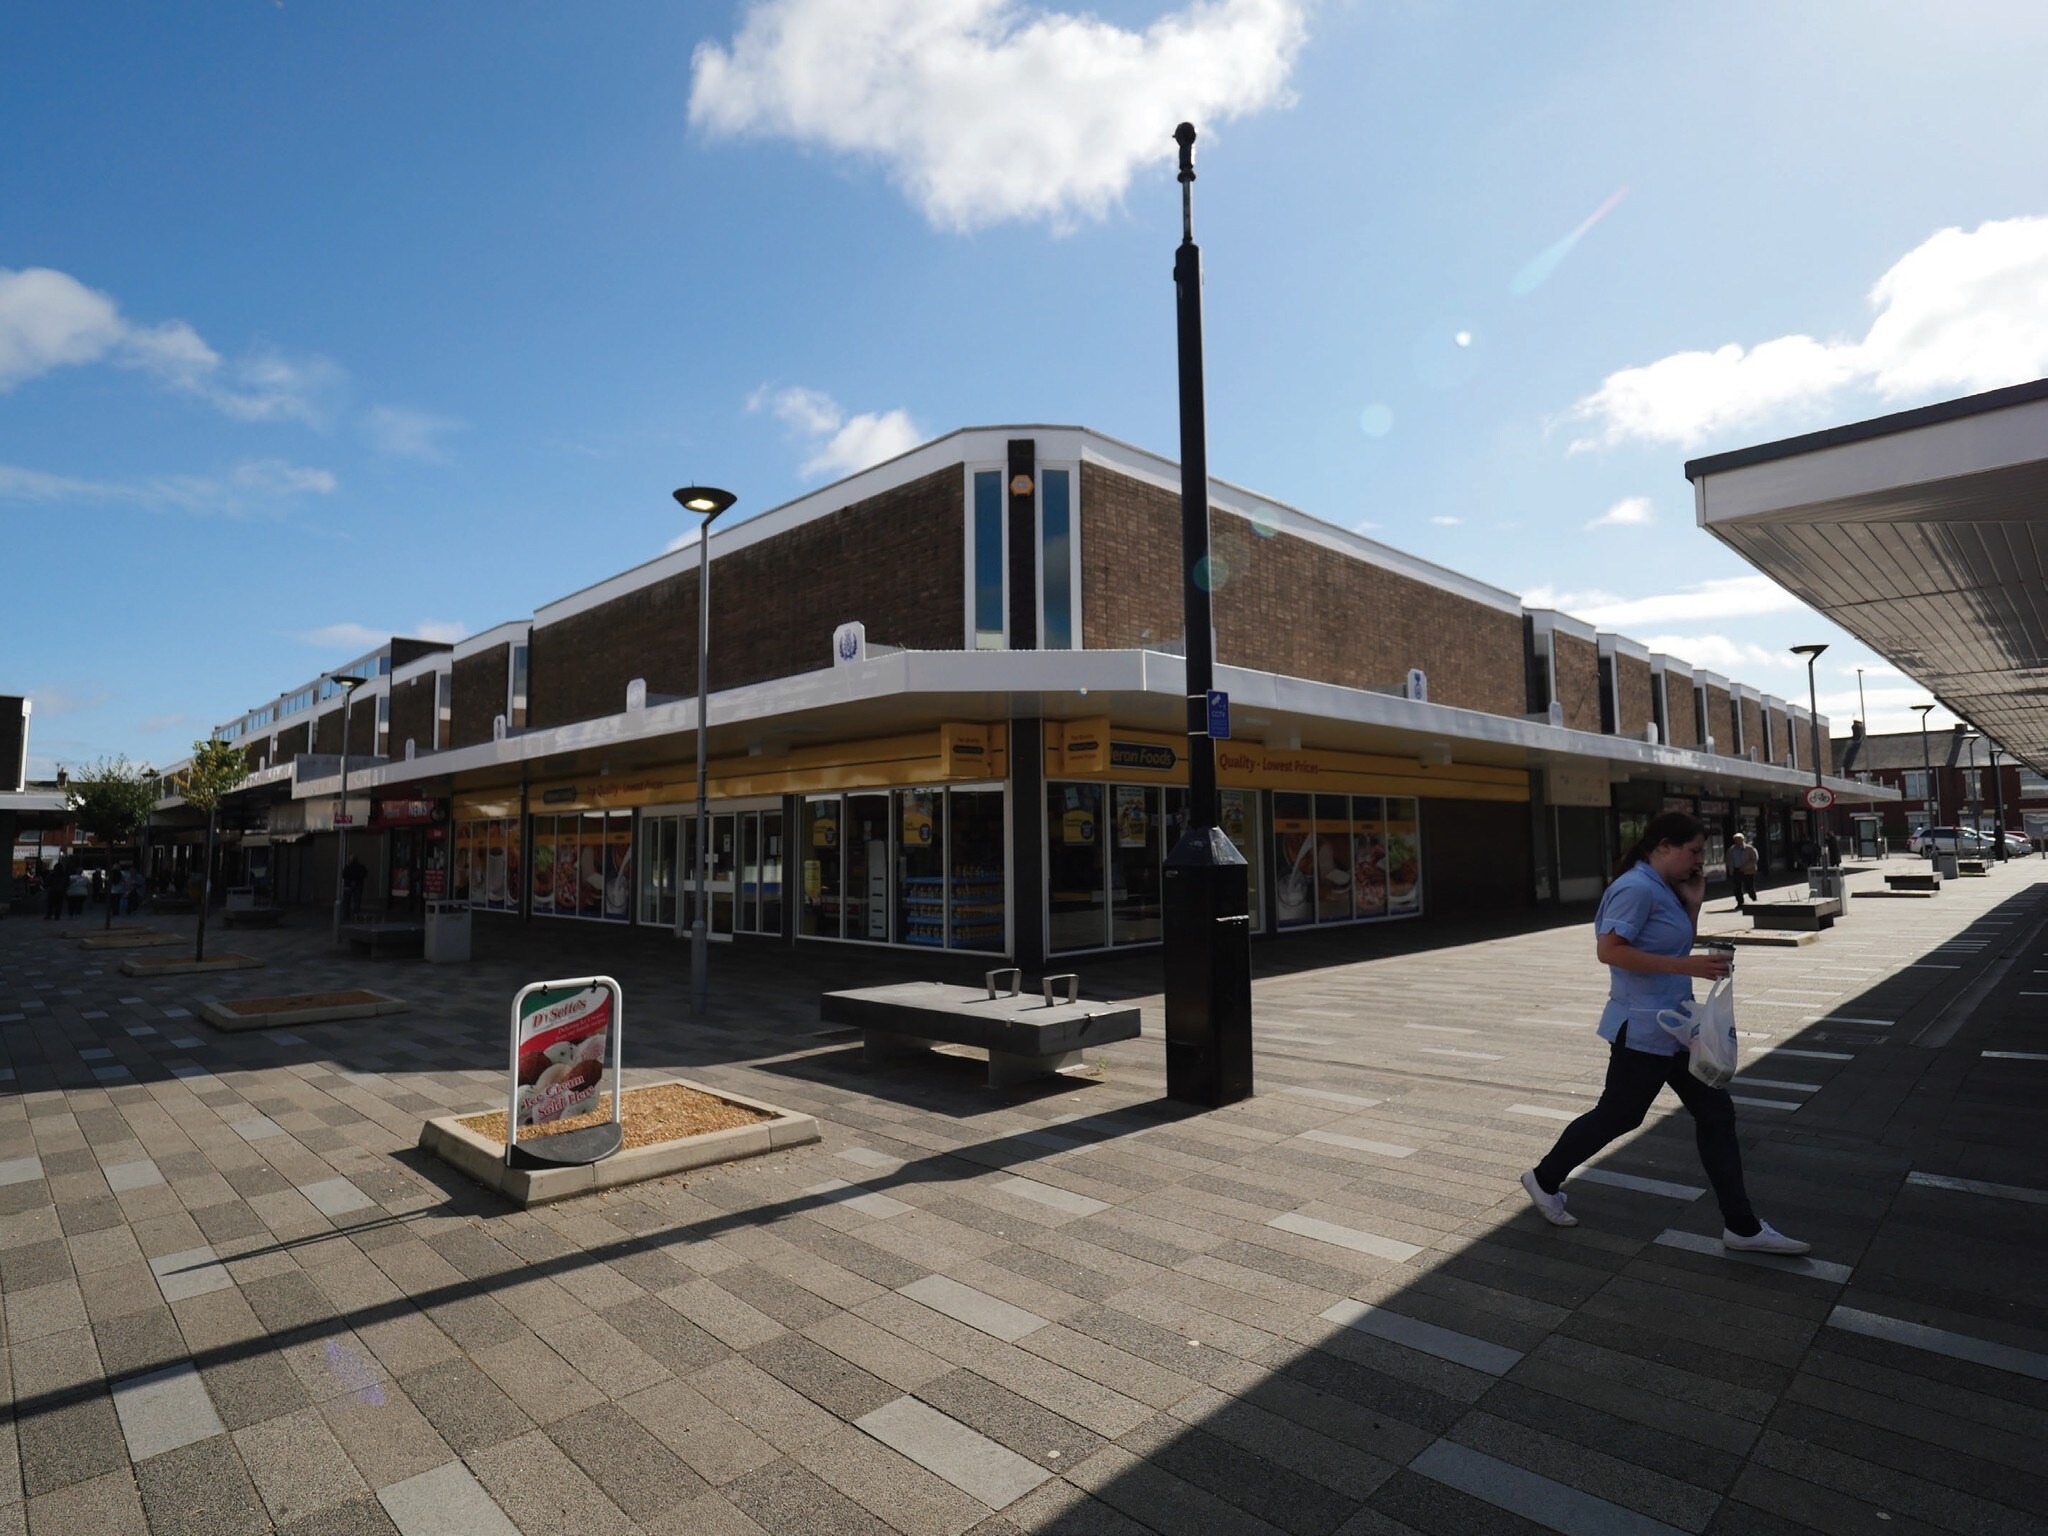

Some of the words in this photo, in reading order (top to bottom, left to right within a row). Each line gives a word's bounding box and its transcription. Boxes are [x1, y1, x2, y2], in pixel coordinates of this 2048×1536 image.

[1211, 710, 1226, 718] CCTV
[1140, 747, 1172, 766] Foods
[1219, 752, 1256, 774] Quality
[1262, 757, 1293, 773] Lowest
[1294, 759, 1319, 774] Prices
[408, 800, 427, 817] NEWS
[523, 1094, 543, 1108] Ice
[545, 1076, 586, 1099] Cream
[538, 1097, 566, 1117] Sold
[568, 1085, 595, 1105] Here
